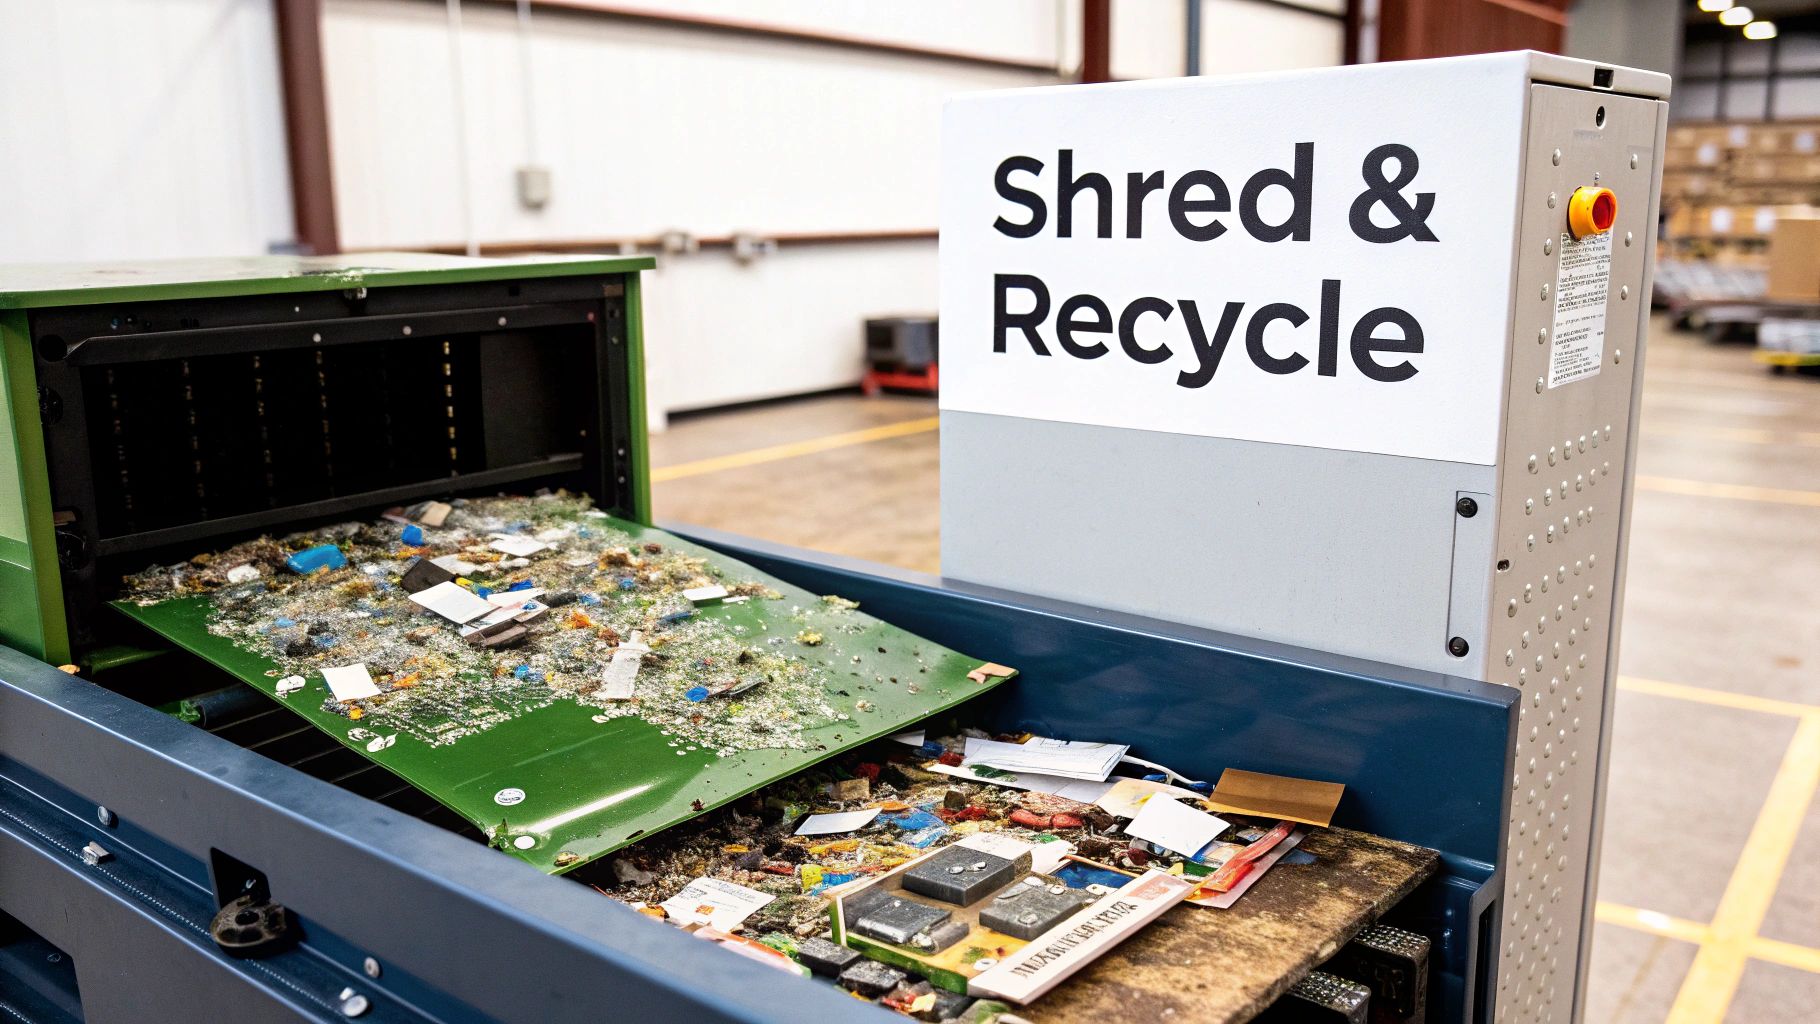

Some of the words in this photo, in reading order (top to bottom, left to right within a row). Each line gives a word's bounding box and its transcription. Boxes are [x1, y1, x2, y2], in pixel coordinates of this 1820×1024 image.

[992, 141, 1315, 244] Shred
[1348, 143, 1441, 244] &
[993, 273, 1425, 389] Recycle
